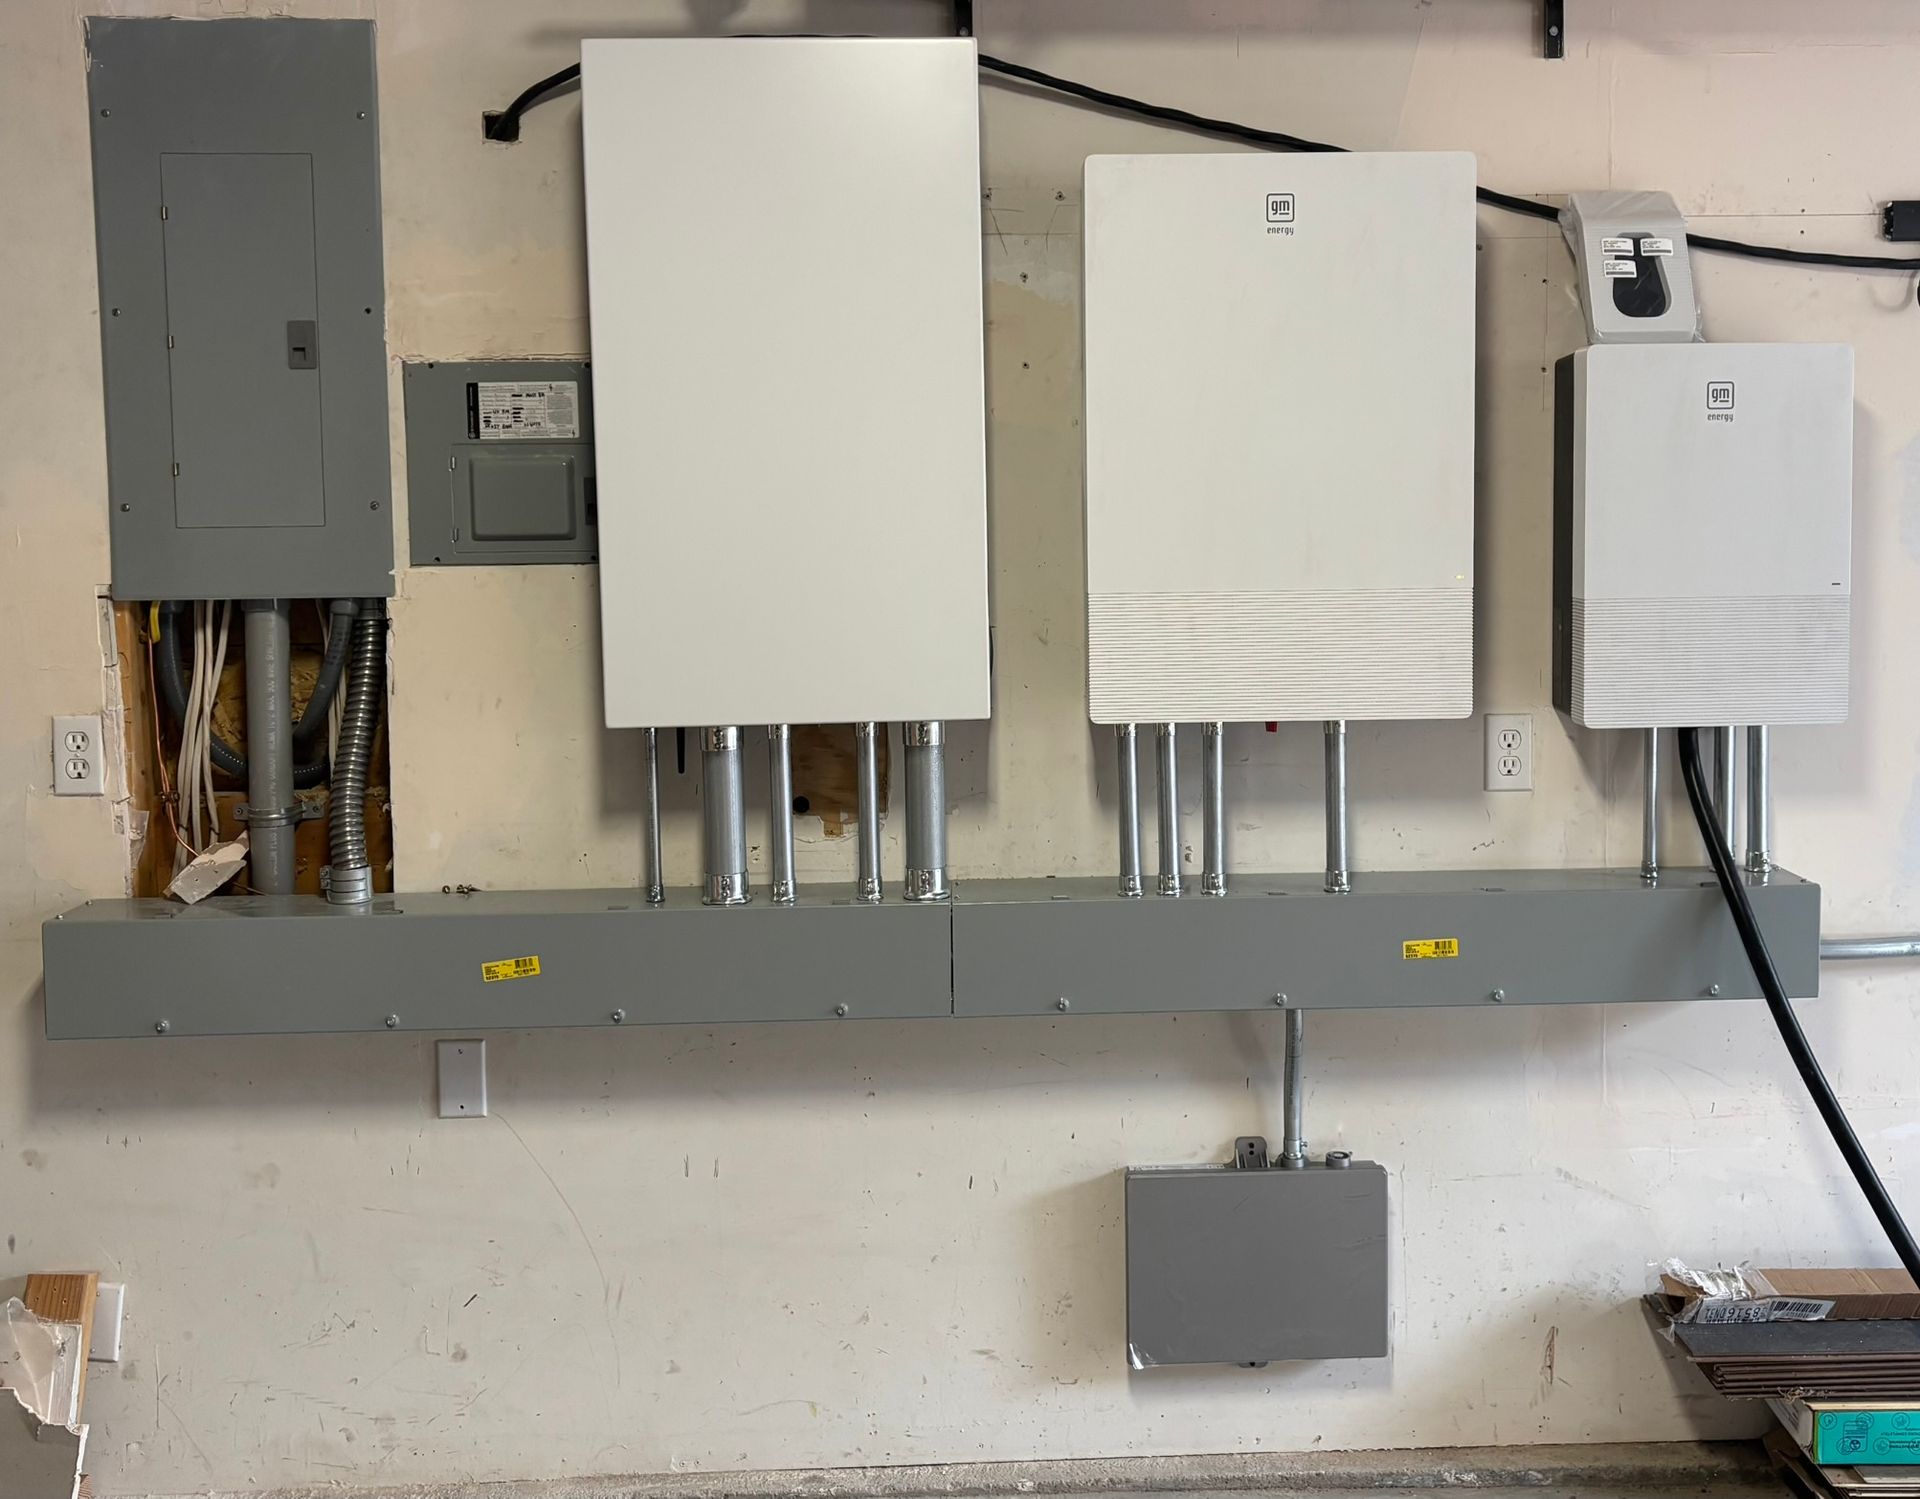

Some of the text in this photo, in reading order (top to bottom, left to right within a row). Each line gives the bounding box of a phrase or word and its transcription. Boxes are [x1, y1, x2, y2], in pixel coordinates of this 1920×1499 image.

[1271, 200, 1290, 216] gm
[1266, 227, 1294, 236] energy
[1711, 388, 1730, 403] gm
[1707, 413, 1734, 423] energy
